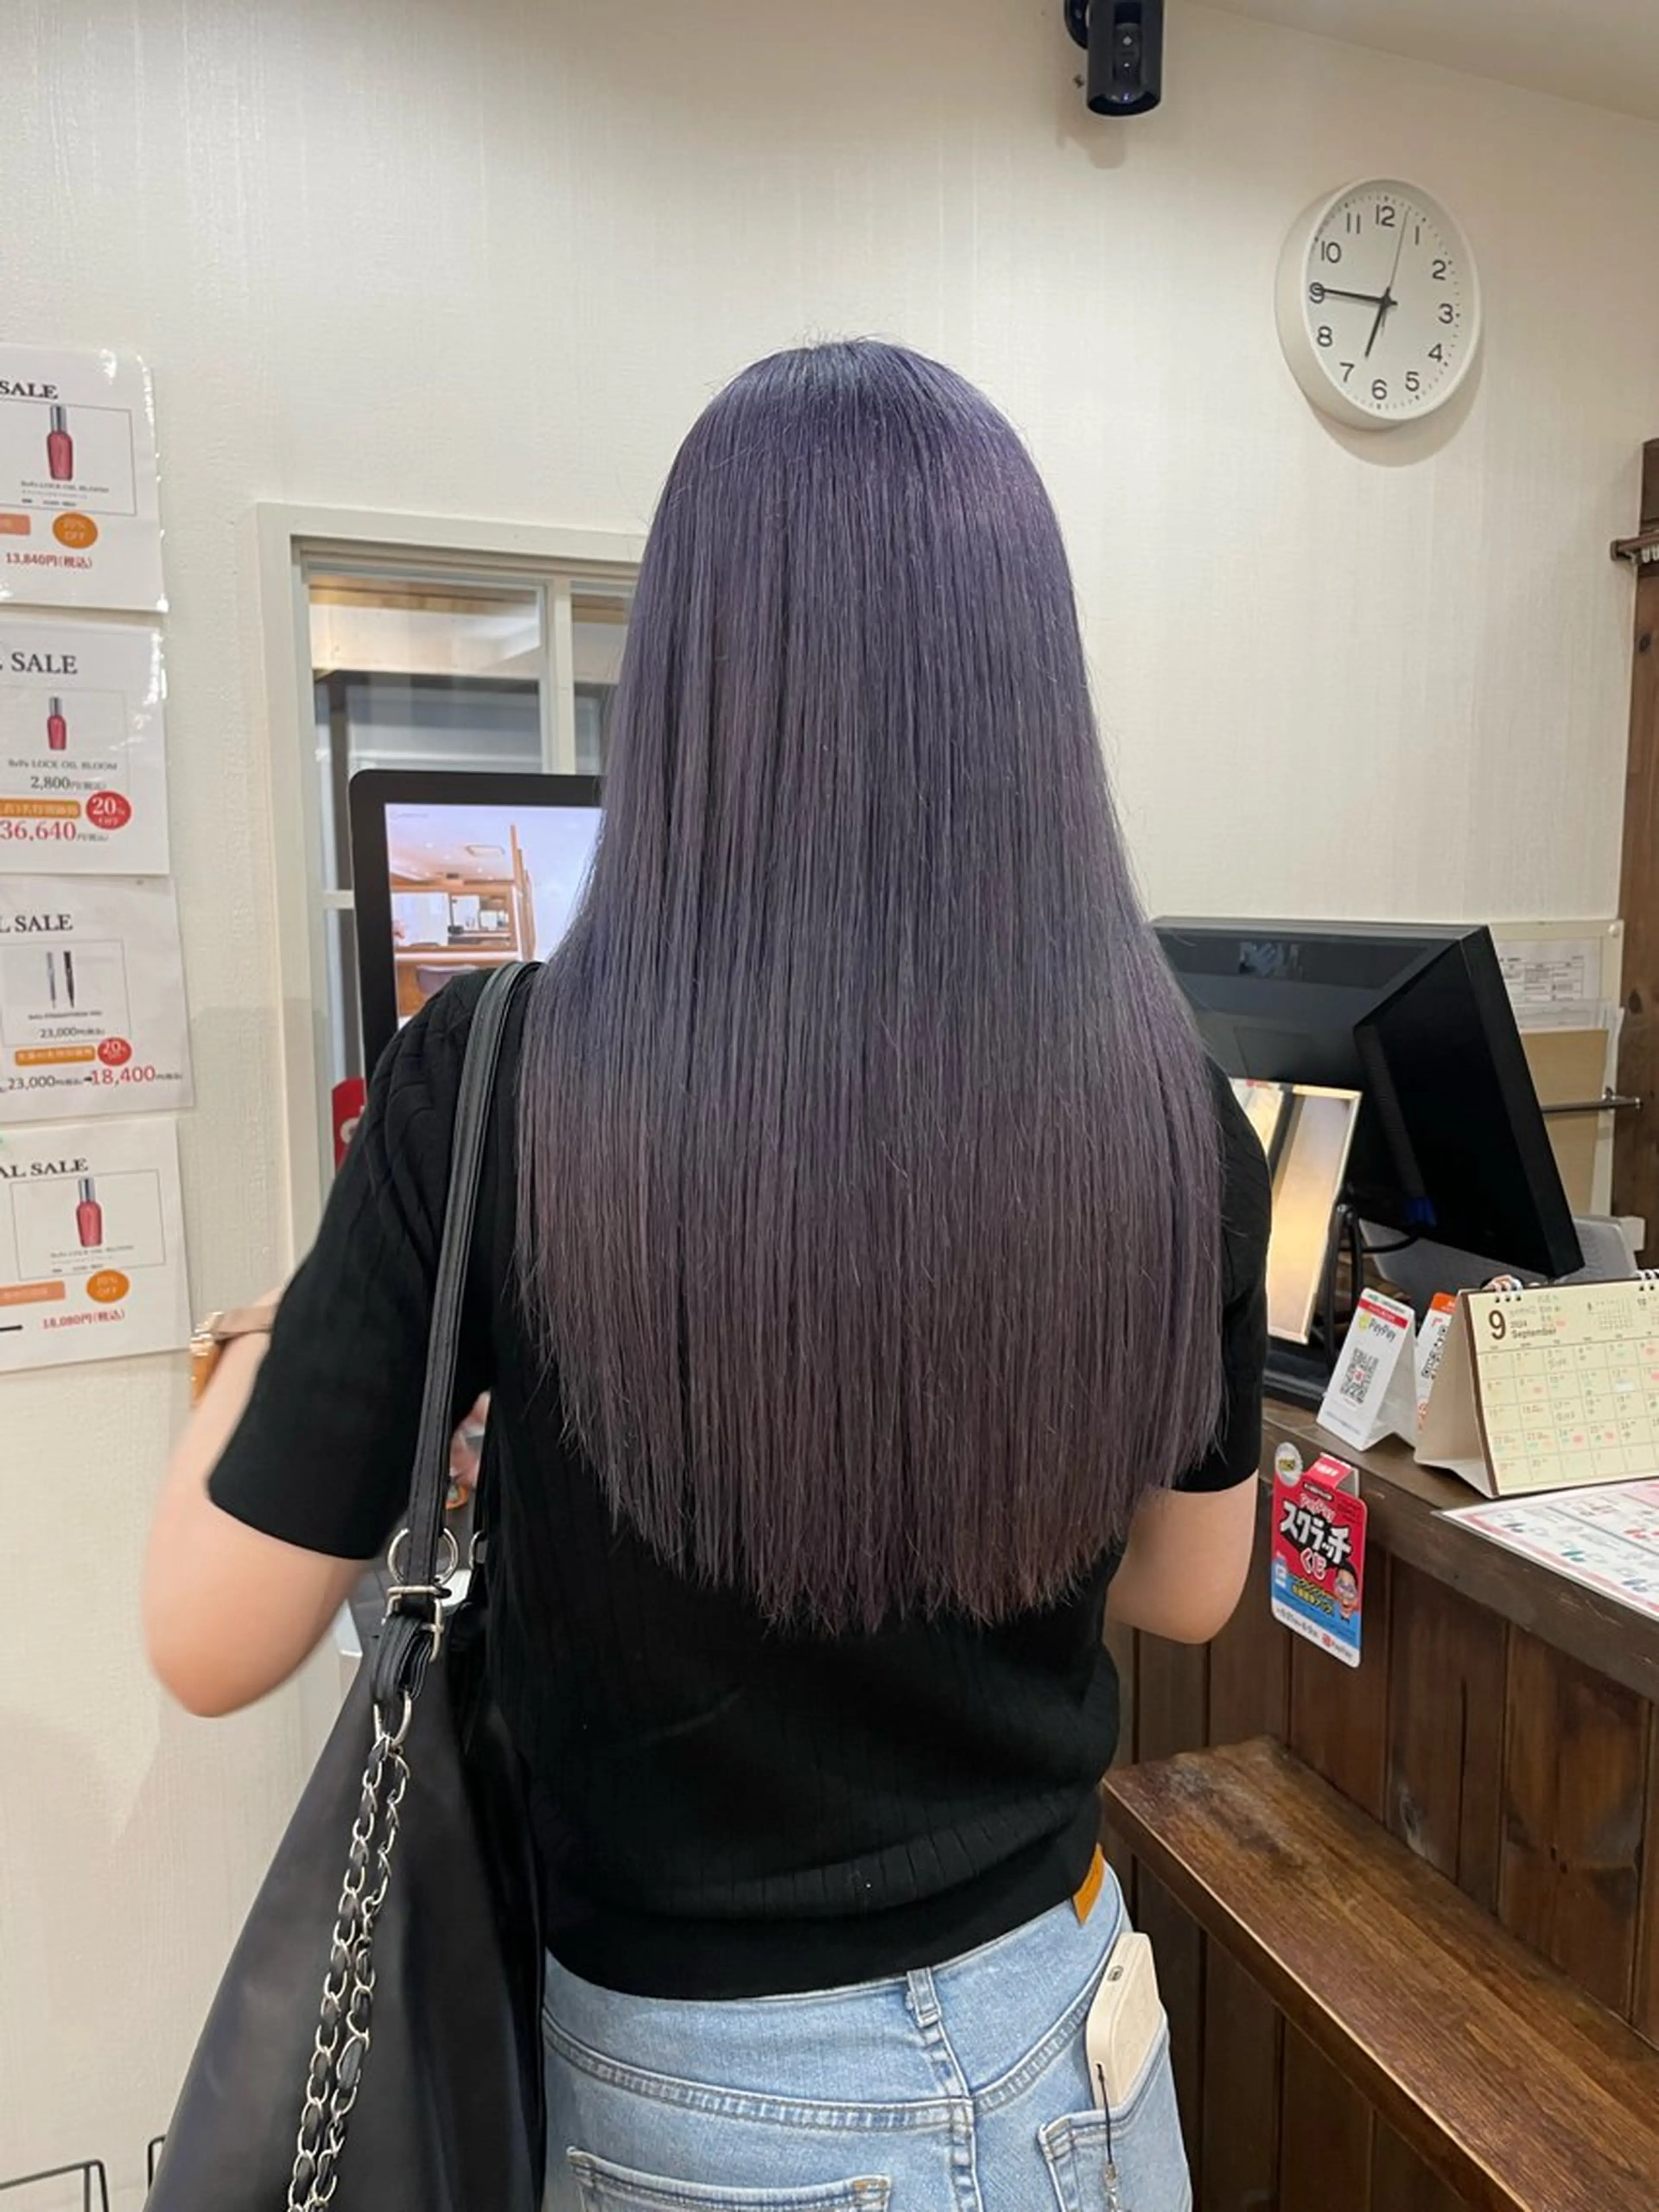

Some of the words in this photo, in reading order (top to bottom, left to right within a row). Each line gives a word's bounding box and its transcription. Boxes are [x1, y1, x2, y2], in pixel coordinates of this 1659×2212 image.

[1347, 213, 1361, 234] 11
[1376, 205, 1395, 227] 12
[1414, 225, 1420, 245] 1
[1321, 241, 1342, 263] 10
[1432, 260, 1446, 280] 2
[1309, 282, 1325, 303] 9
[1438, 303, 1453, 324] 3
[1317, 326, 1333, 347] 8
[1427, 343, 1443, 362] 4
[1340, 362, 1354, 382] 7
[1405, 371, 1420, 391] 5
[0, 380, 58, 399] SALE
[1371, 379, 1387, 400] 6
[11, 651, 78, 674] SALE
[15, 913, 73, 933] SALE
[30, 1158, 89, 1176] SALE
[1368, 1318, 1396, 1343] PayPay
[1489, 1309, 1506, 1340] 9
[1511, 1328, 1556, 1339] September
[1280, 1500, 1352, 1564] スクラッチ
